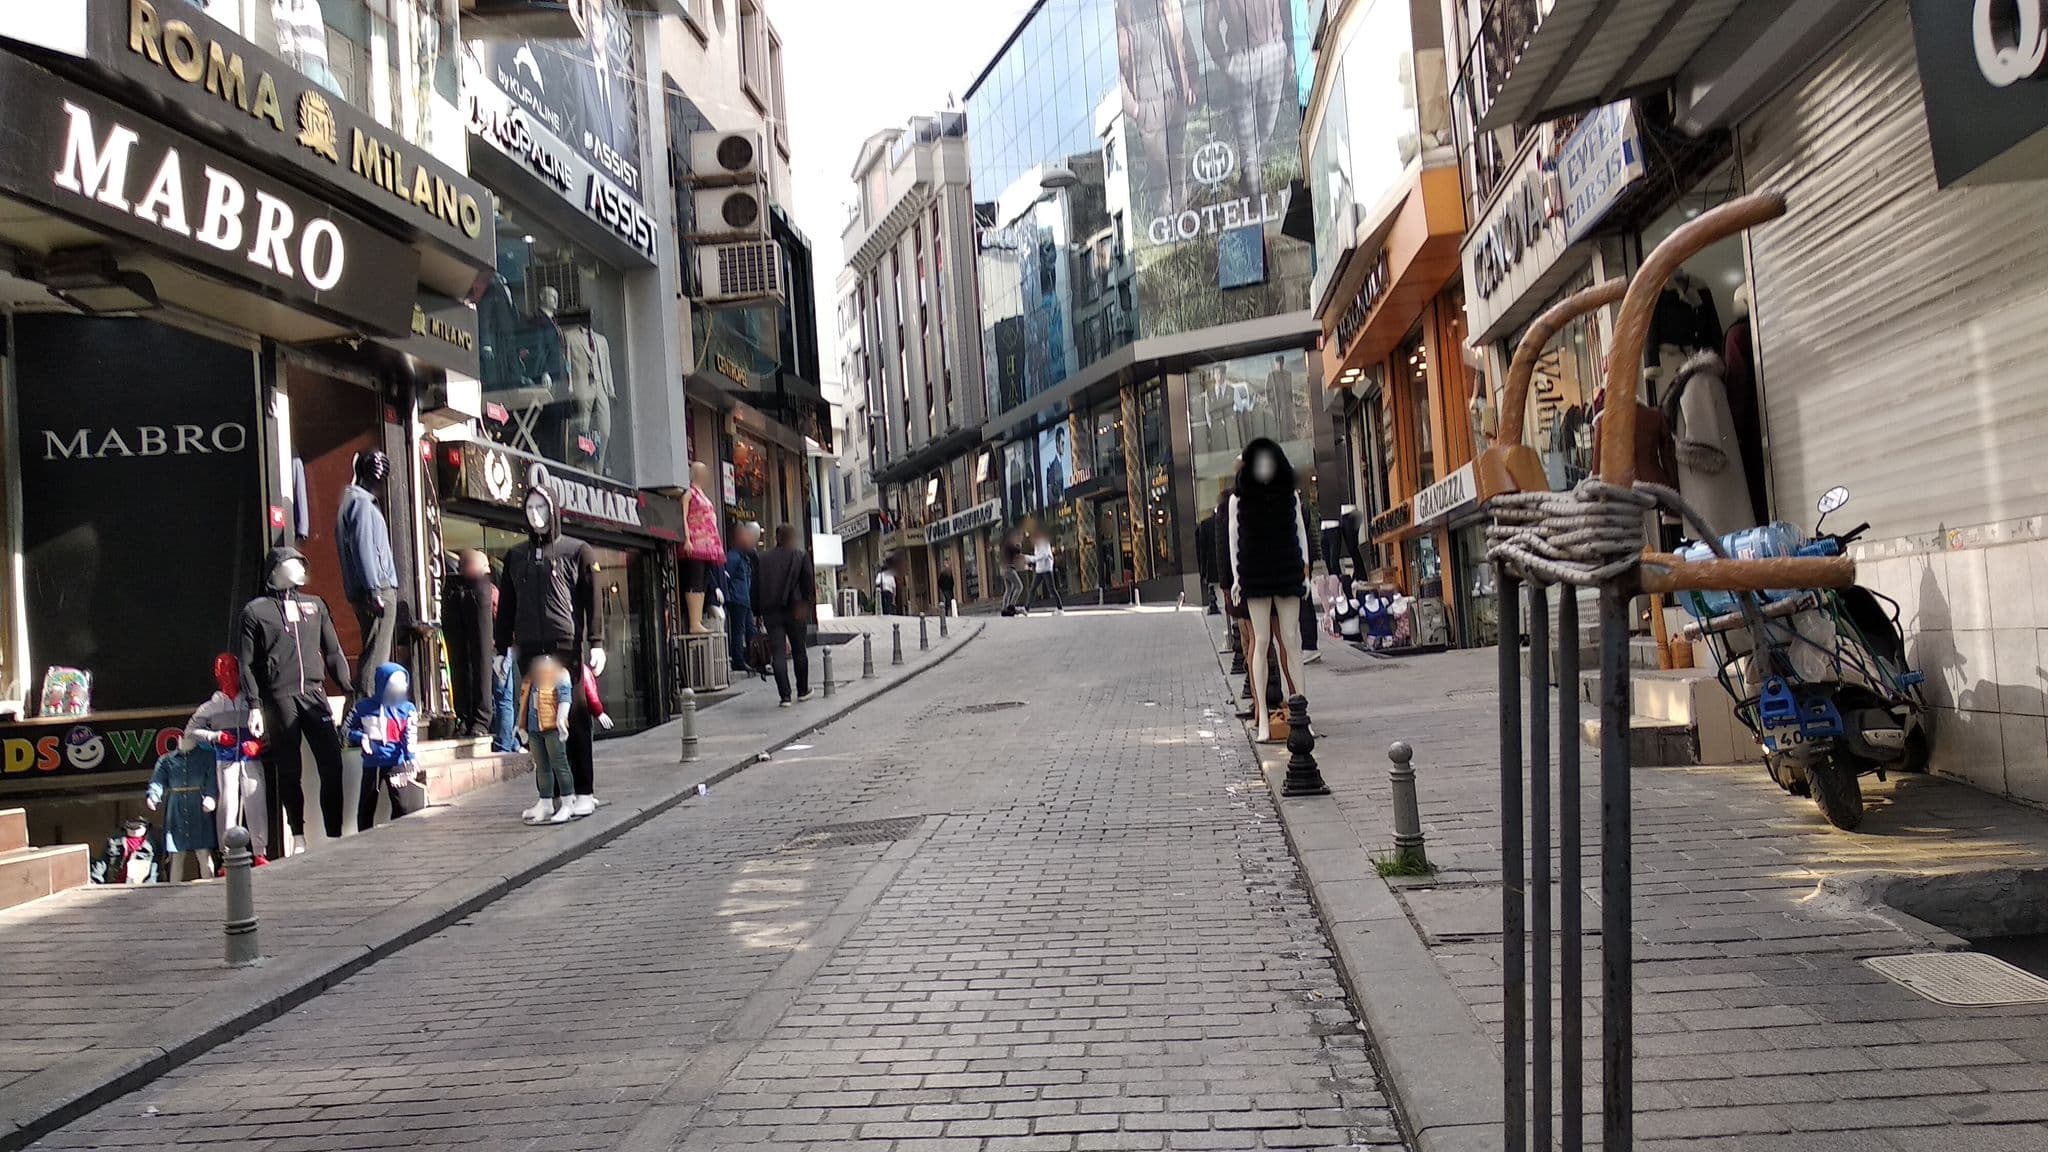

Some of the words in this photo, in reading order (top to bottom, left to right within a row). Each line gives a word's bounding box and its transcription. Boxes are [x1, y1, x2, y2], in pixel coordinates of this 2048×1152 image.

[129, 0, 286, 132] ROMA
[53, 98, 345, 291] MABRO
[594, 135, 639, 193] ASSIST
[586, 172, 658, 256] ASSIST
[41, 422, 246, 460] MABRO
[530, 462, 642, 527] ODERMARK
[1419, 471, 1467, 519] GRANDEZZA
